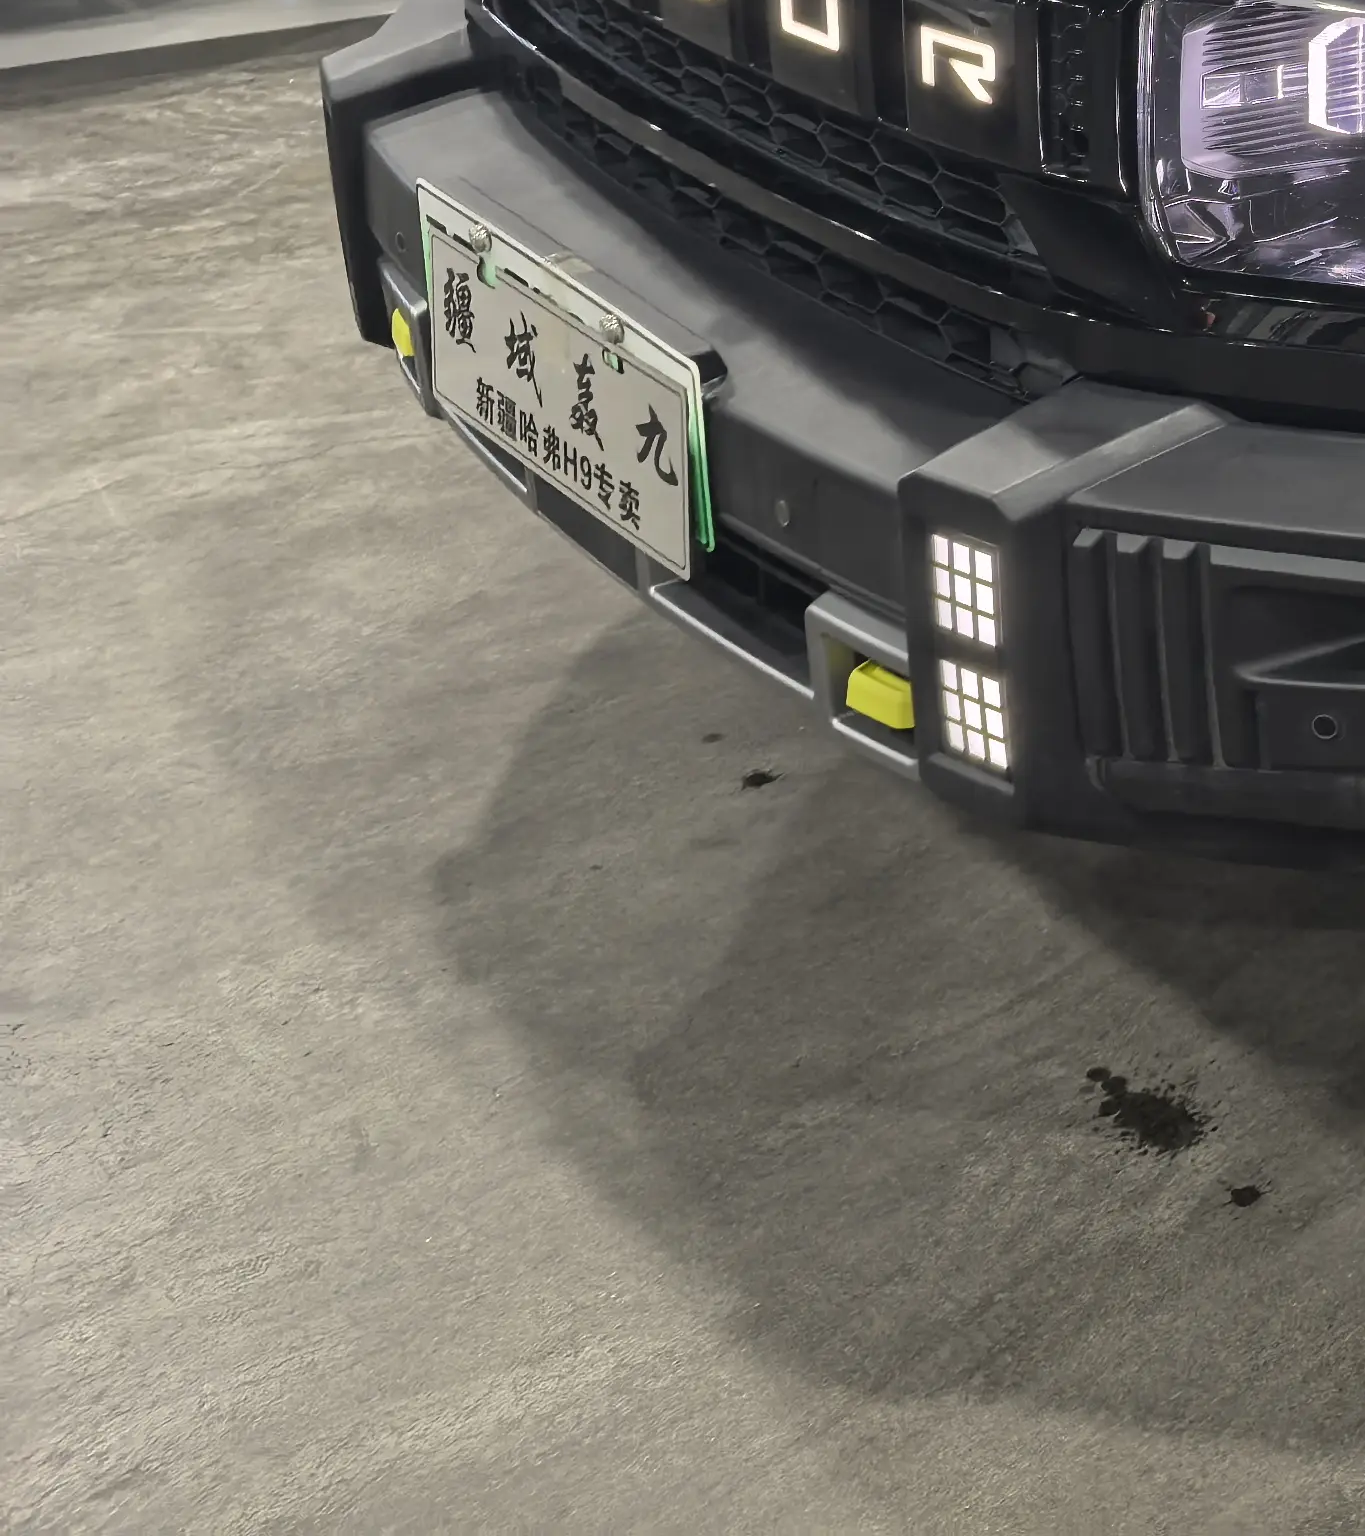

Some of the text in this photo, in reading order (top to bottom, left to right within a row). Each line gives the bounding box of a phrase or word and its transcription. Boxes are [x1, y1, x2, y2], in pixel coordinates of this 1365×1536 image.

[443, 267, 679, 487] 疆域轰九
[475, 377, 642, 531] 新疆哈弗H9专卖
